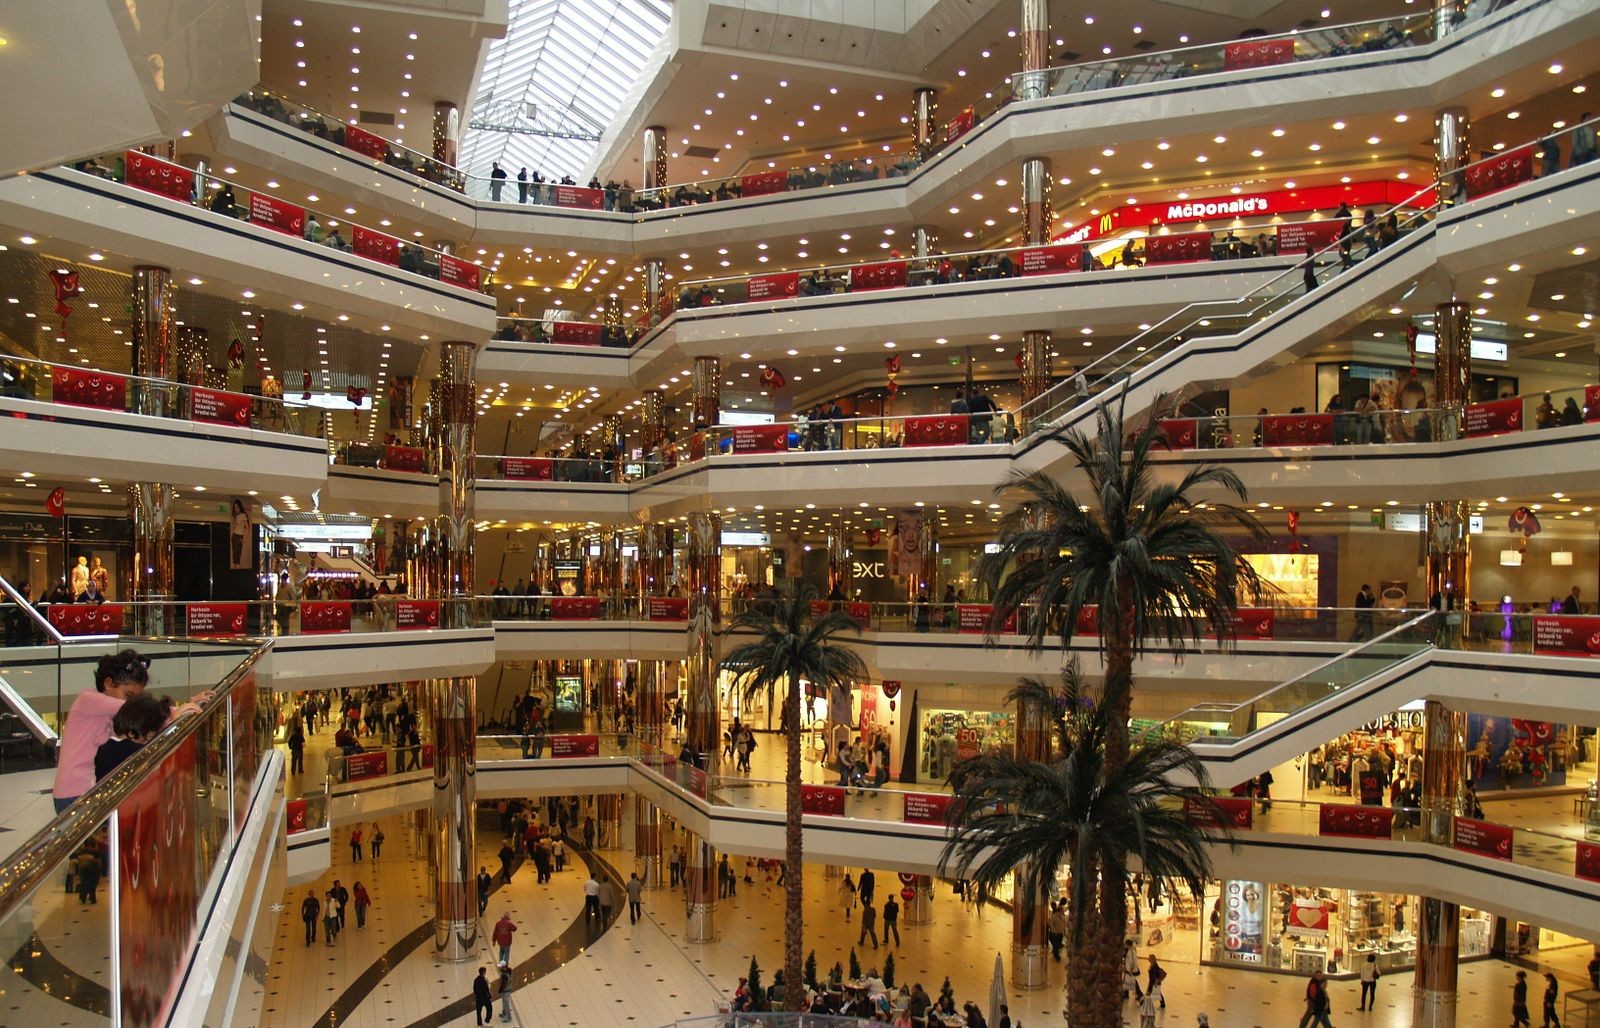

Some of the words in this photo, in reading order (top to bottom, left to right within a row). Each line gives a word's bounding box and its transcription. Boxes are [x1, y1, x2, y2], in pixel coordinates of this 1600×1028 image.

[1168, 198, 1268, 219] McDonald's
[853, 562, 884, 578] ext
[961, 729, 977, 742] 50
